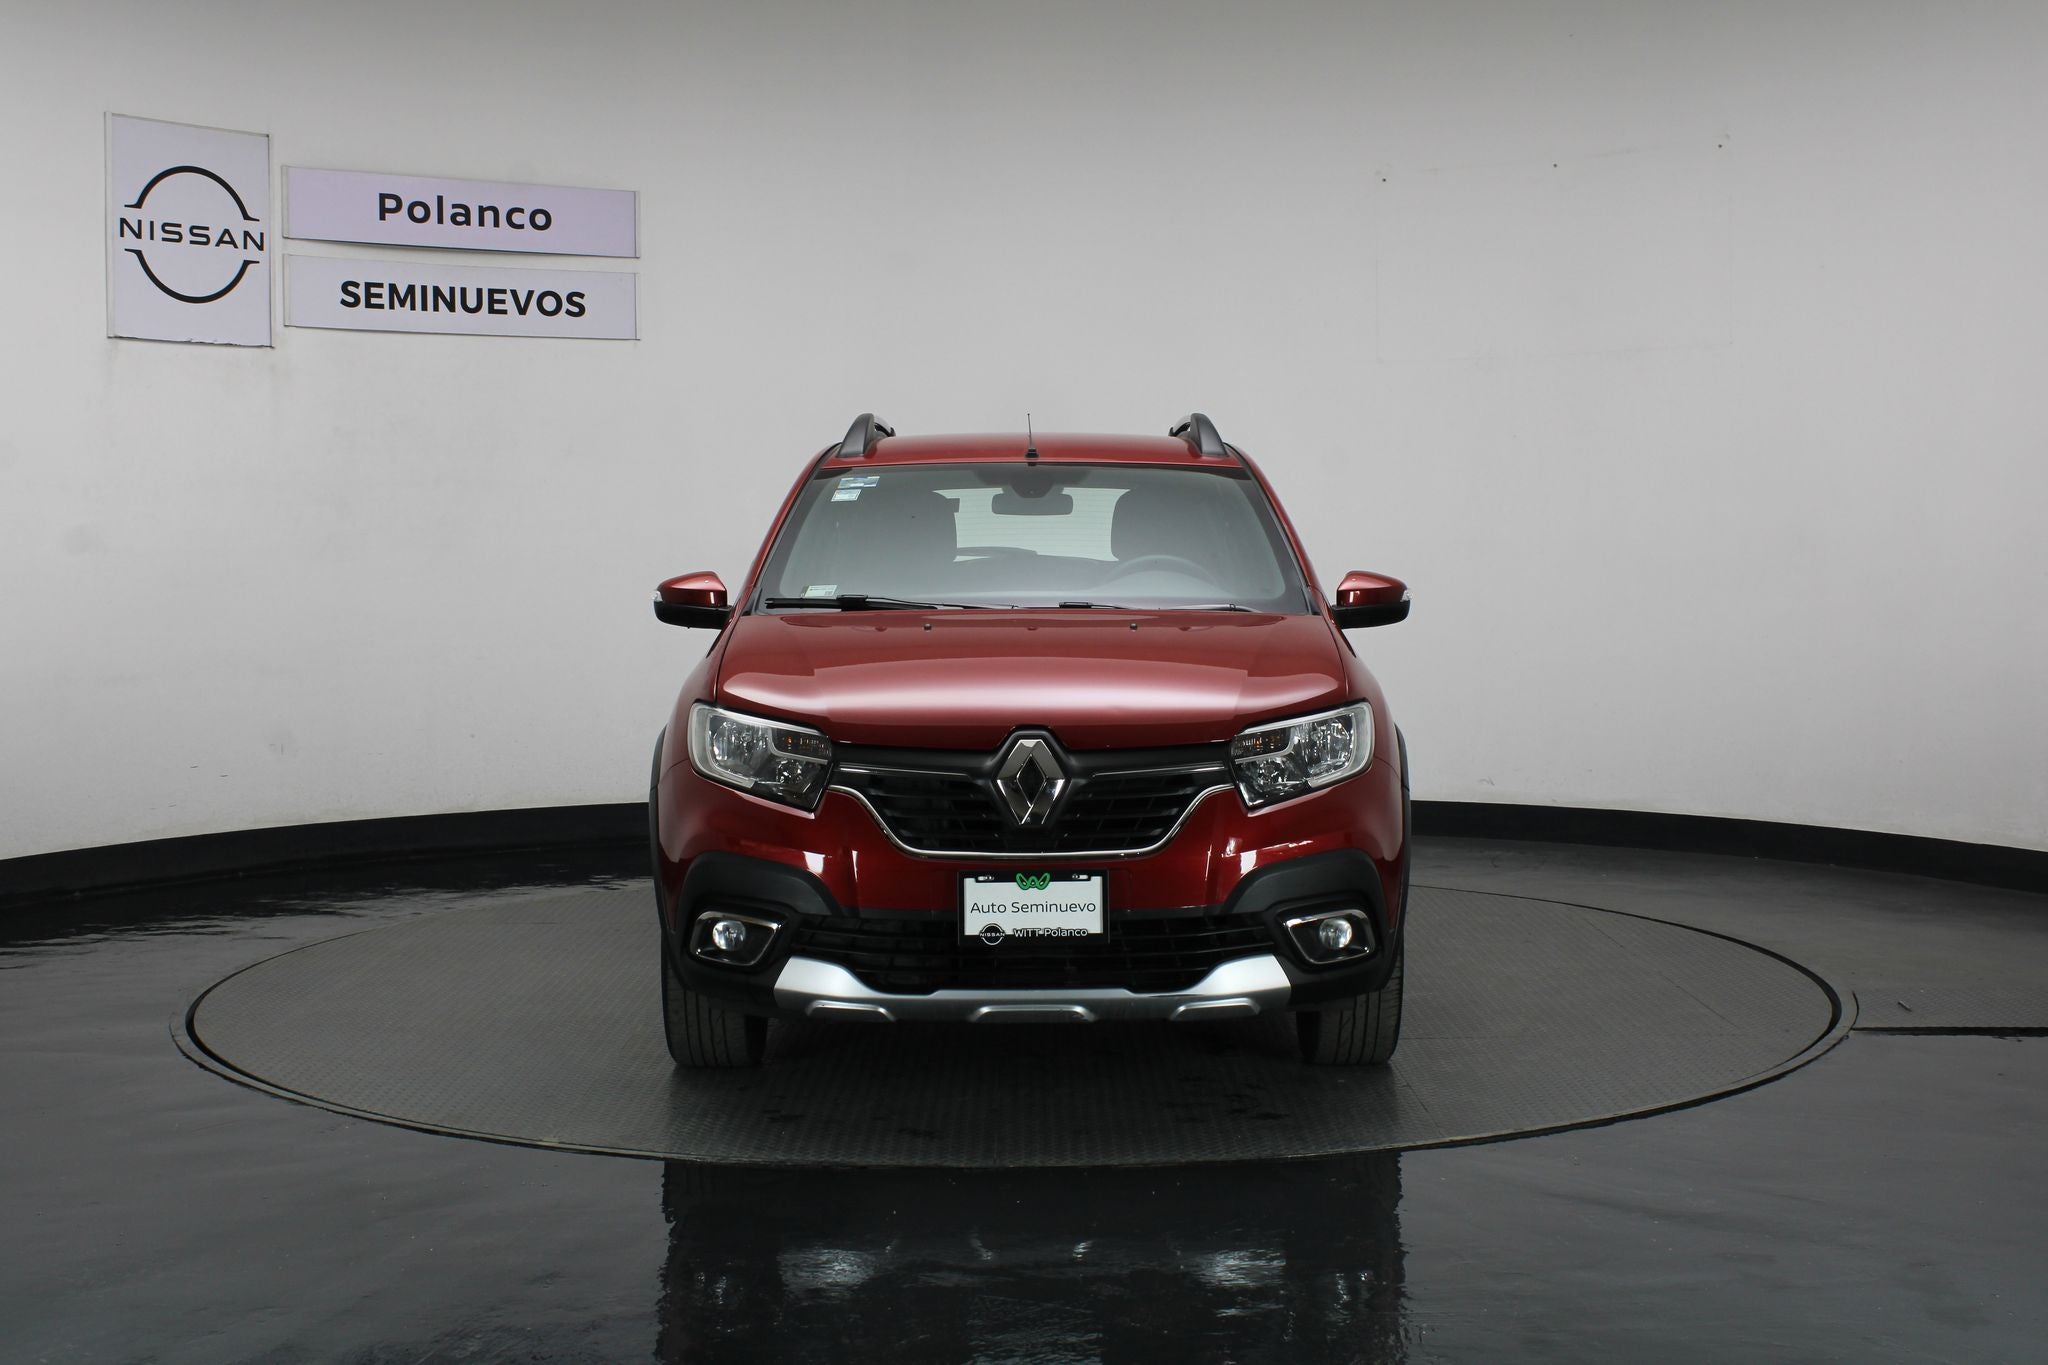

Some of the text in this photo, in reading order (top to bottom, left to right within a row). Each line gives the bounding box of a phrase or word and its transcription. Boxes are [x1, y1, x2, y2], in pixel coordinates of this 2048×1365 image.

[378, 192, 552, 231] Polanco
[119, 217, 265, 252] NISSAN
[340, 280, 586, 318] SEMINUEVOS
[970, 901, 1097, 914] Auto Seminuevo
[1044, 927, 1088, 937] Polanco
